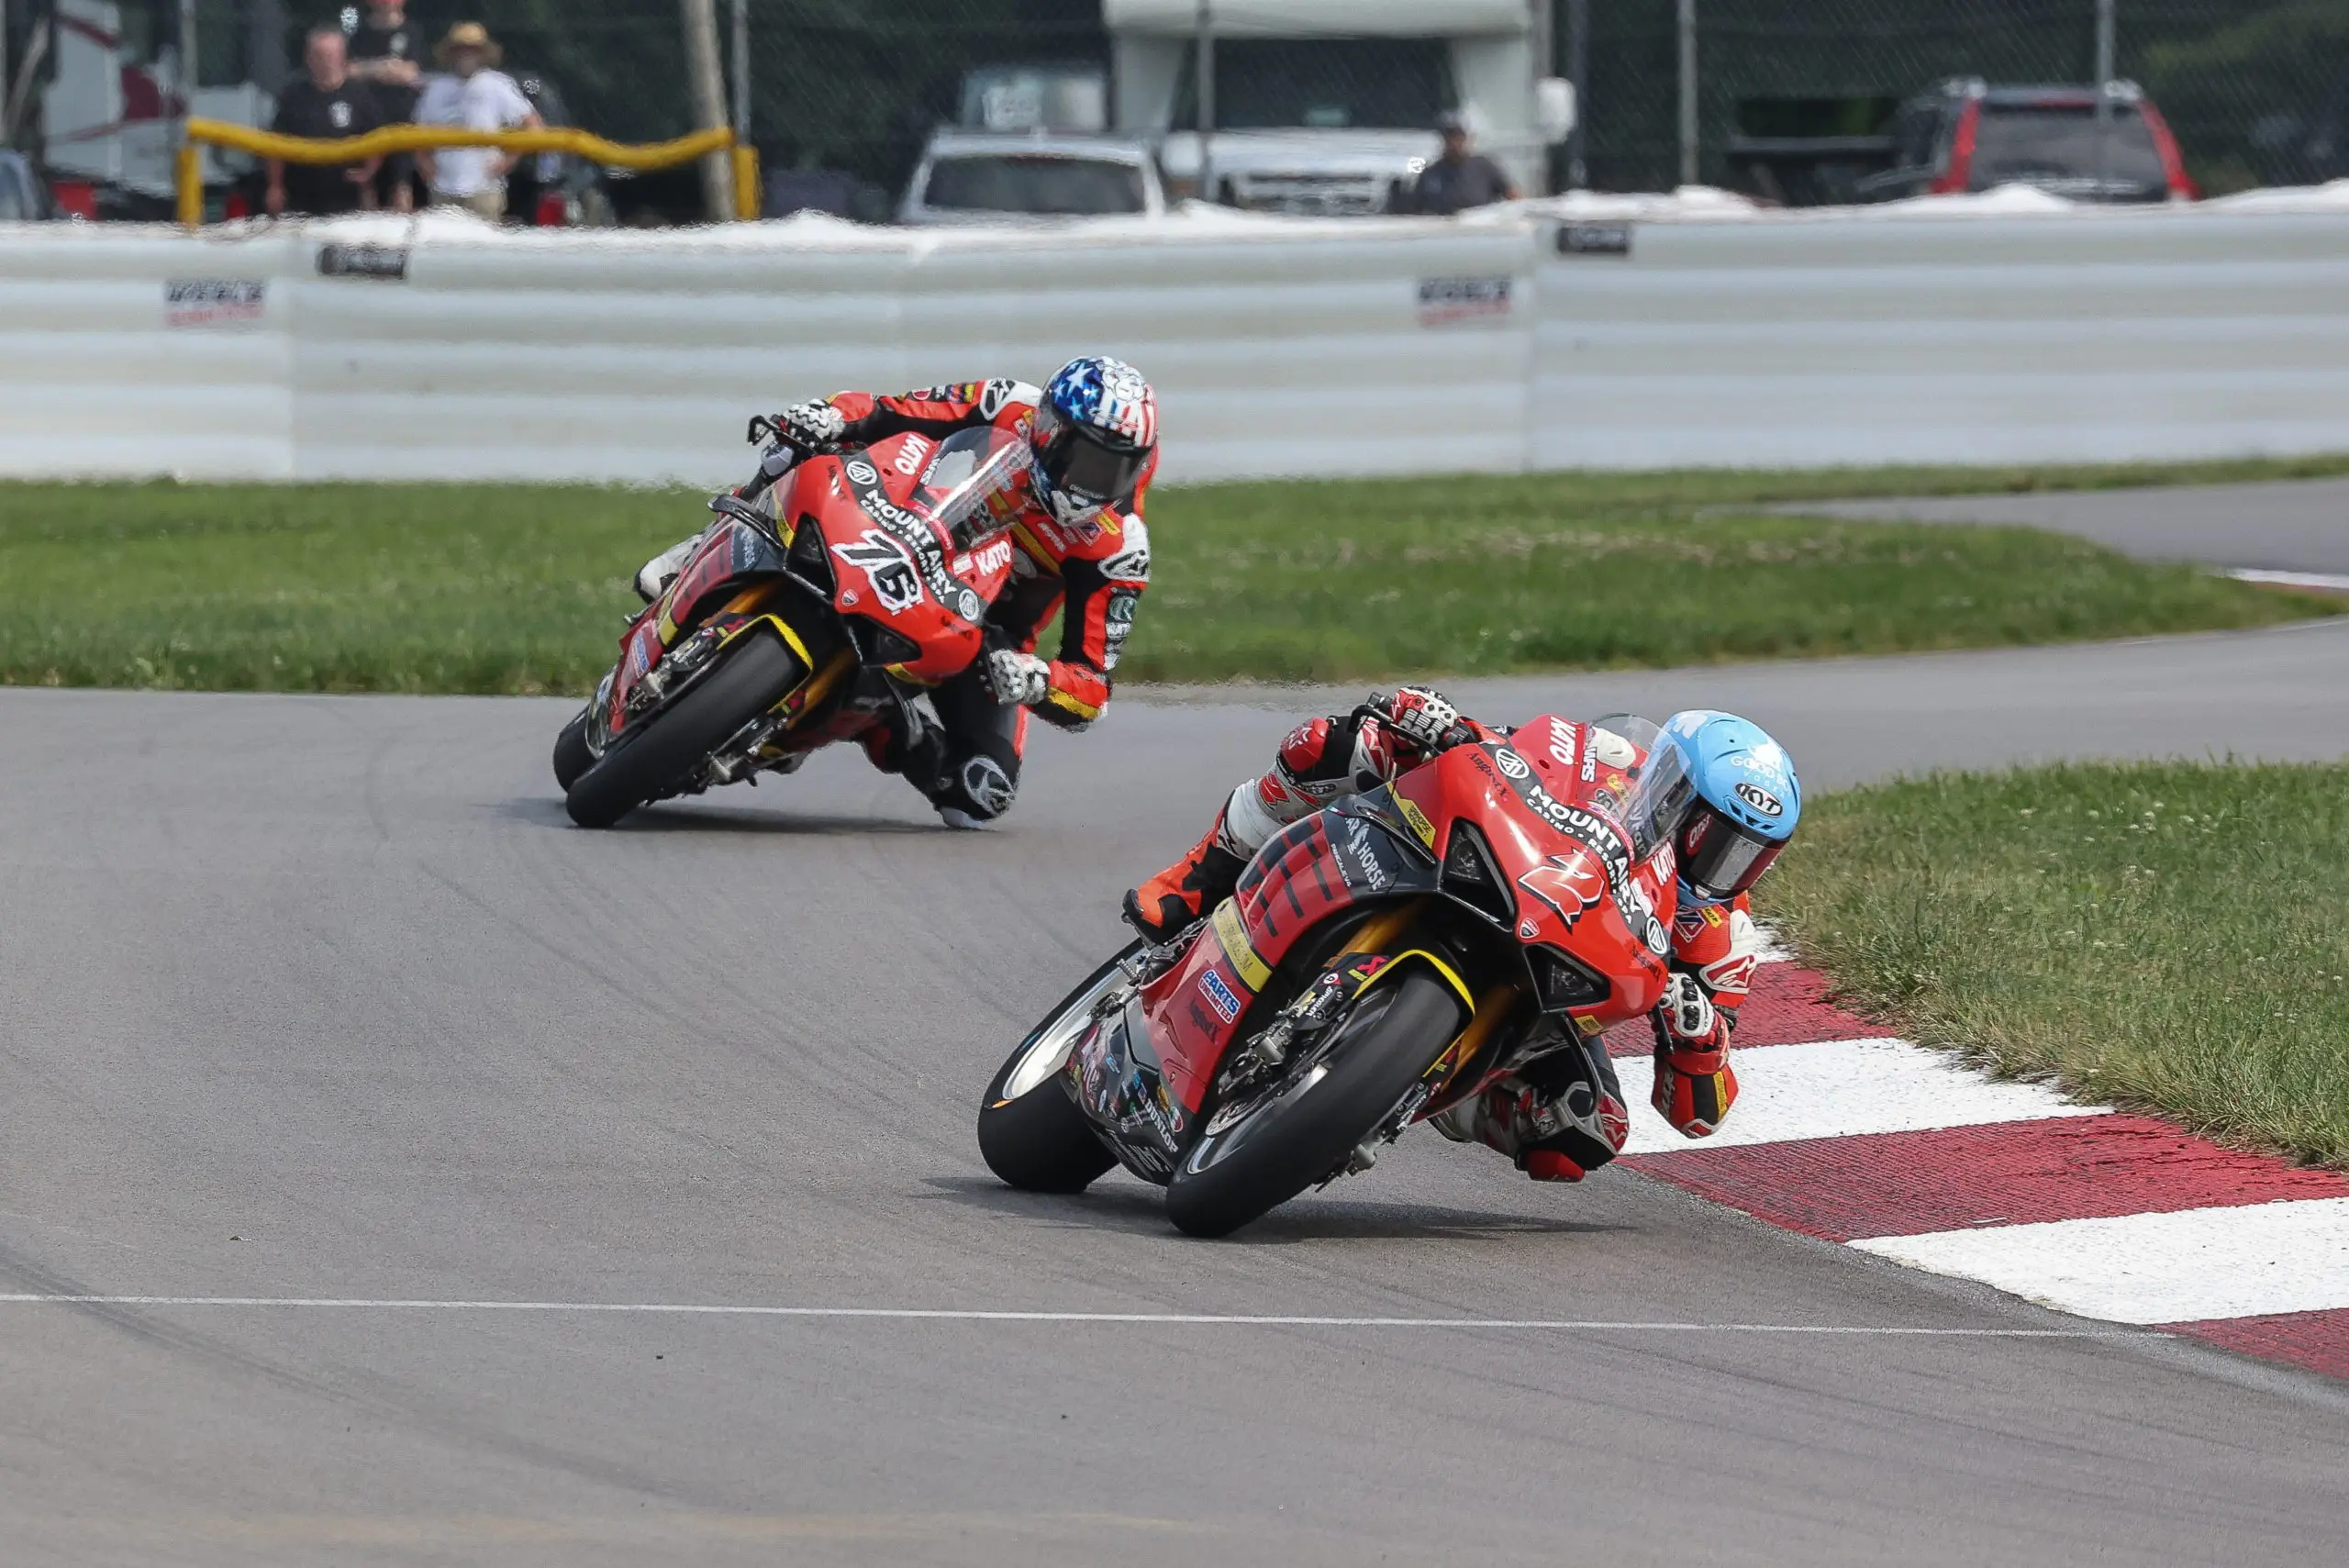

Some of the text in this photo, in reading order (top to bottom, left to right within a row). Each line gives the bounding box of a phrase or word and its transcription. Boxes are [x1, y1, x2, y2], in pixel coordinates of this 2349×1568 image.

[895, 433, 930, 476] KATO
[865, 489, 958, 595] MOUNT AIRY
[974, 539, 1011, 577] KATO
[829, 528, 925, 617] 76
[1549, 716, 1577, 765] KATO
[1579, 746, 1598, 783] WRS
[1739, 784, 1780, 812] KYT
[1357, 841, 1386, 892] HORSE
[1526, 797, 1575, 835] CASINO
[1587, 838, 1618, 890] RESORT
[1617, 898, 1632, 925] SPA
[1529, 784, 1622, 851] MOUNT
[1615, 856, 1642, 913] AIRY
[1203, 971, 1239, 1015] PARTS
[1146, 1098, 1179, 1153] DUNLOP
